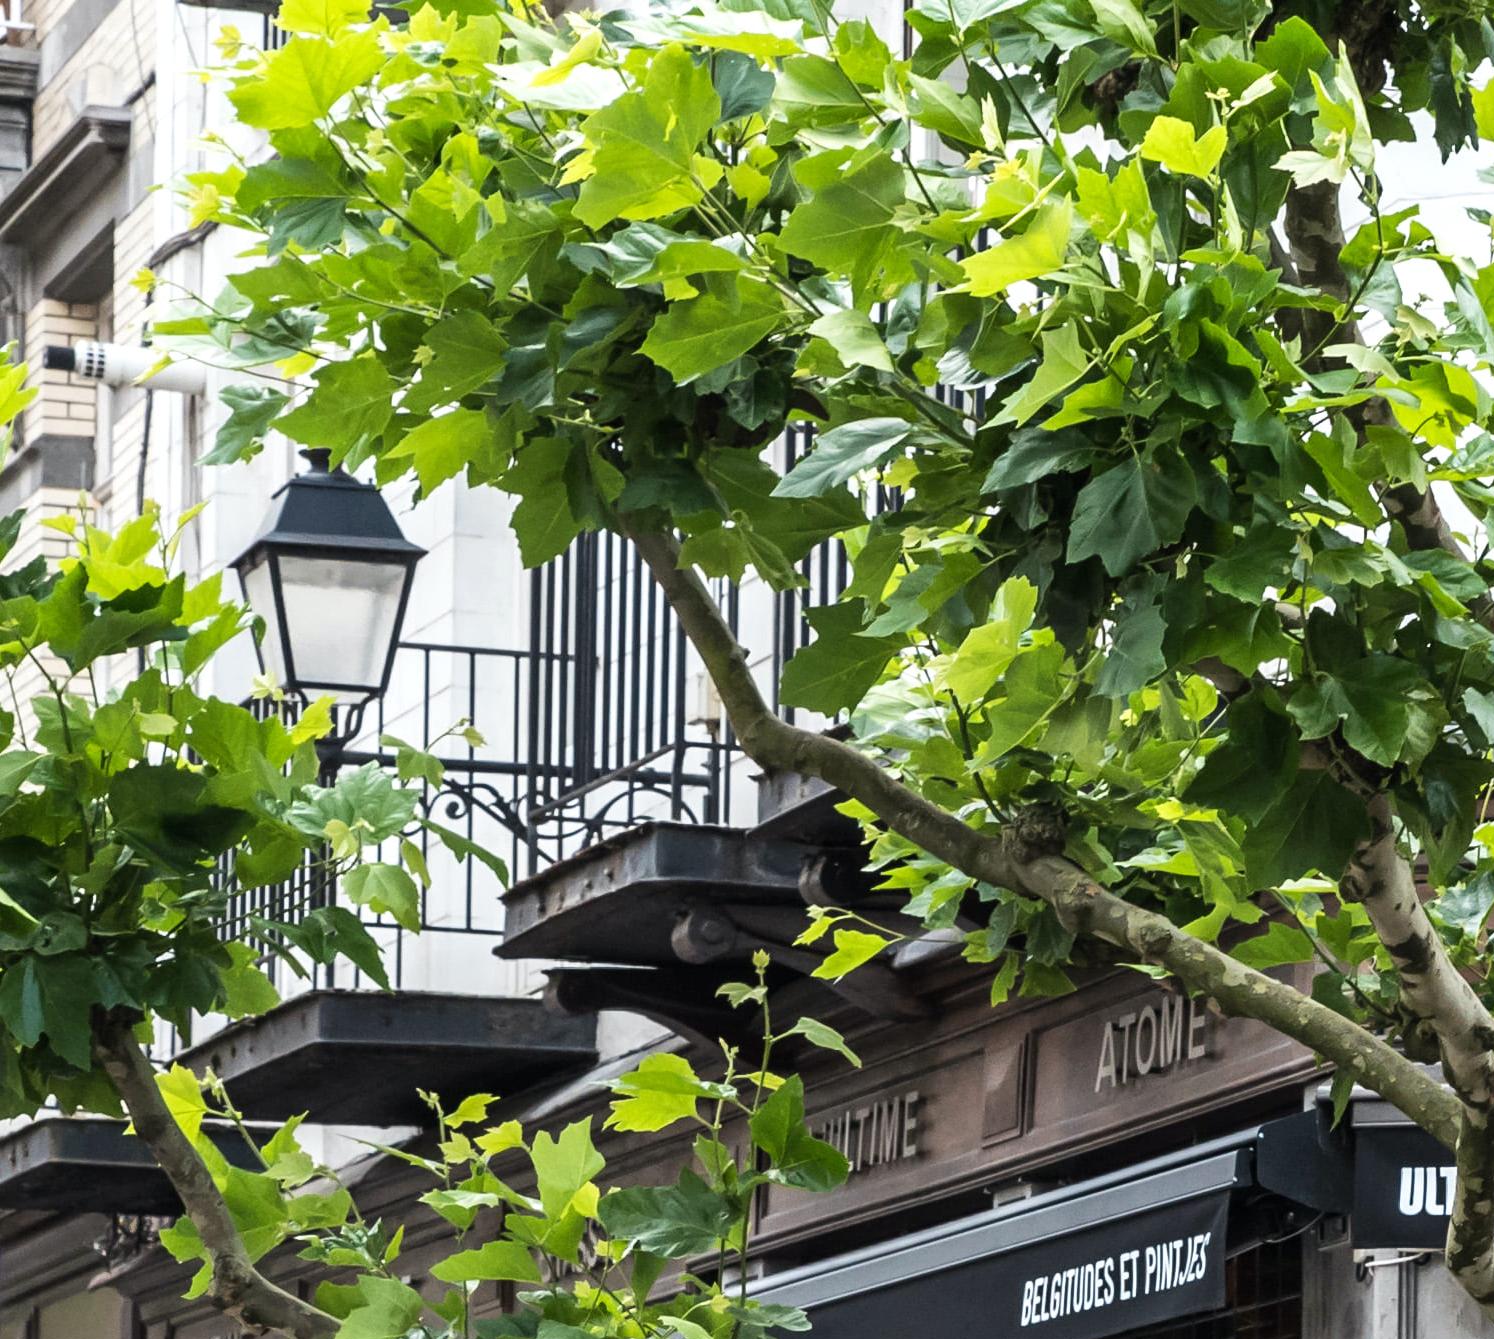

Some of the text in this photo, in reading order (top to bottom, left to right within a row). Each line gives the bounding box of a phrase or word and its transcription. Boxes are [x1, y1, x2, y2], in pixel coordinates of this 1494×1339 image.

[1095, 993, 1206, 1092] ATOME
[1020, 1231, 1212, 1327] BELGITUDES ET PINTJES
